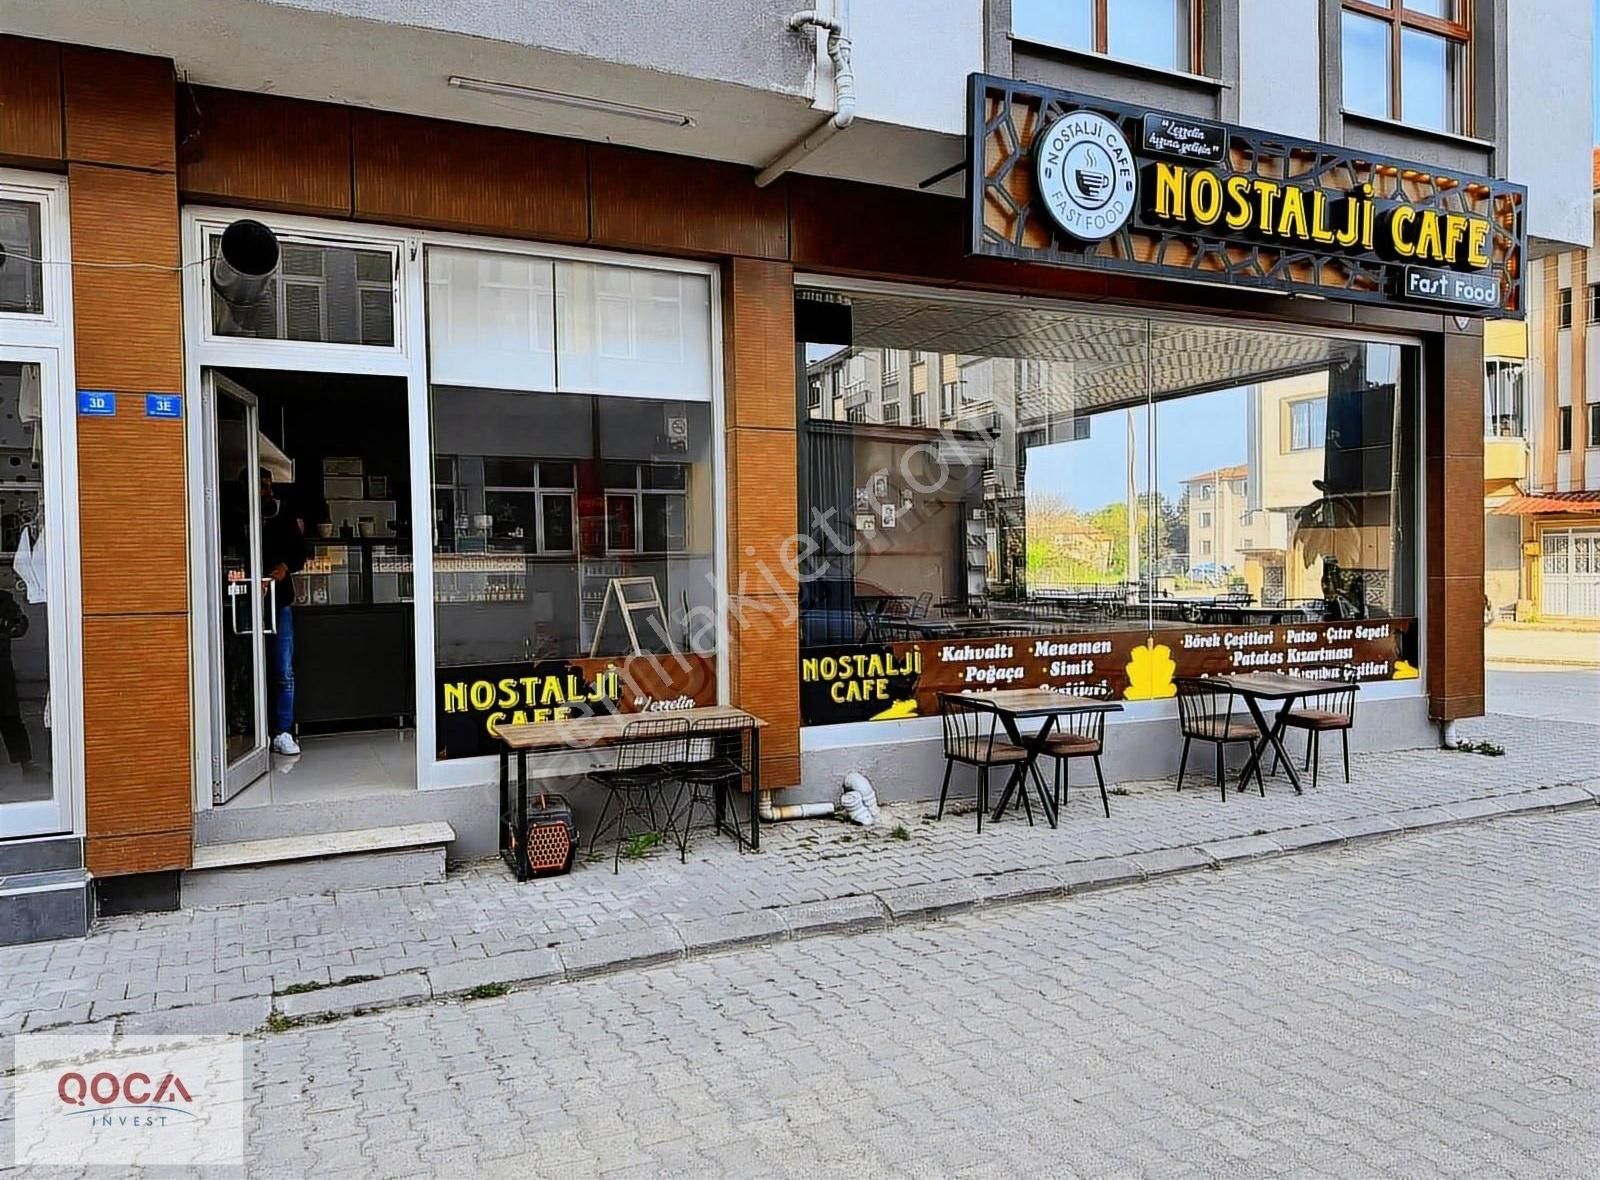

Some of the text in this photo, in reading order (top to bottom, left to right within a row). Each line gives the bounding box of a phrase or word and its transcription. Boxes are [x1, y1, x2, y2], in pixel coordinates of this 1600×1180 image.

[1047, 120, 1131, 177] NOSTALJİ CAFE
[1051, 190, 1125, 230] FAST FOOD
[1155, 161, 1491, 268] NOSTALJİ CAFE
[1410, 273, 1497, 302] Fast Food
[89, 398, 105, 408] 3D
[156, 400, 172, 411] 3E
[1183, 632, 1221, 649] Börek
[1223, 630, 1274, 650] Çeşitleri
[1286, 629, 1318, 644] Patso
[1355, 623, 1390, 641] Sepeti
[802, 645, 922, 682] NOSTALJİ
[941, 640, 1112, 662] Kahvaltı Menemen
[1232, 647, 1353, 667] Patates Kızartması
[964, 659, 1095, 684] Poğaça Simit
[443, 663, 620, 713] NOSTALJİ
[830, 678, 889, 704] CAFE
